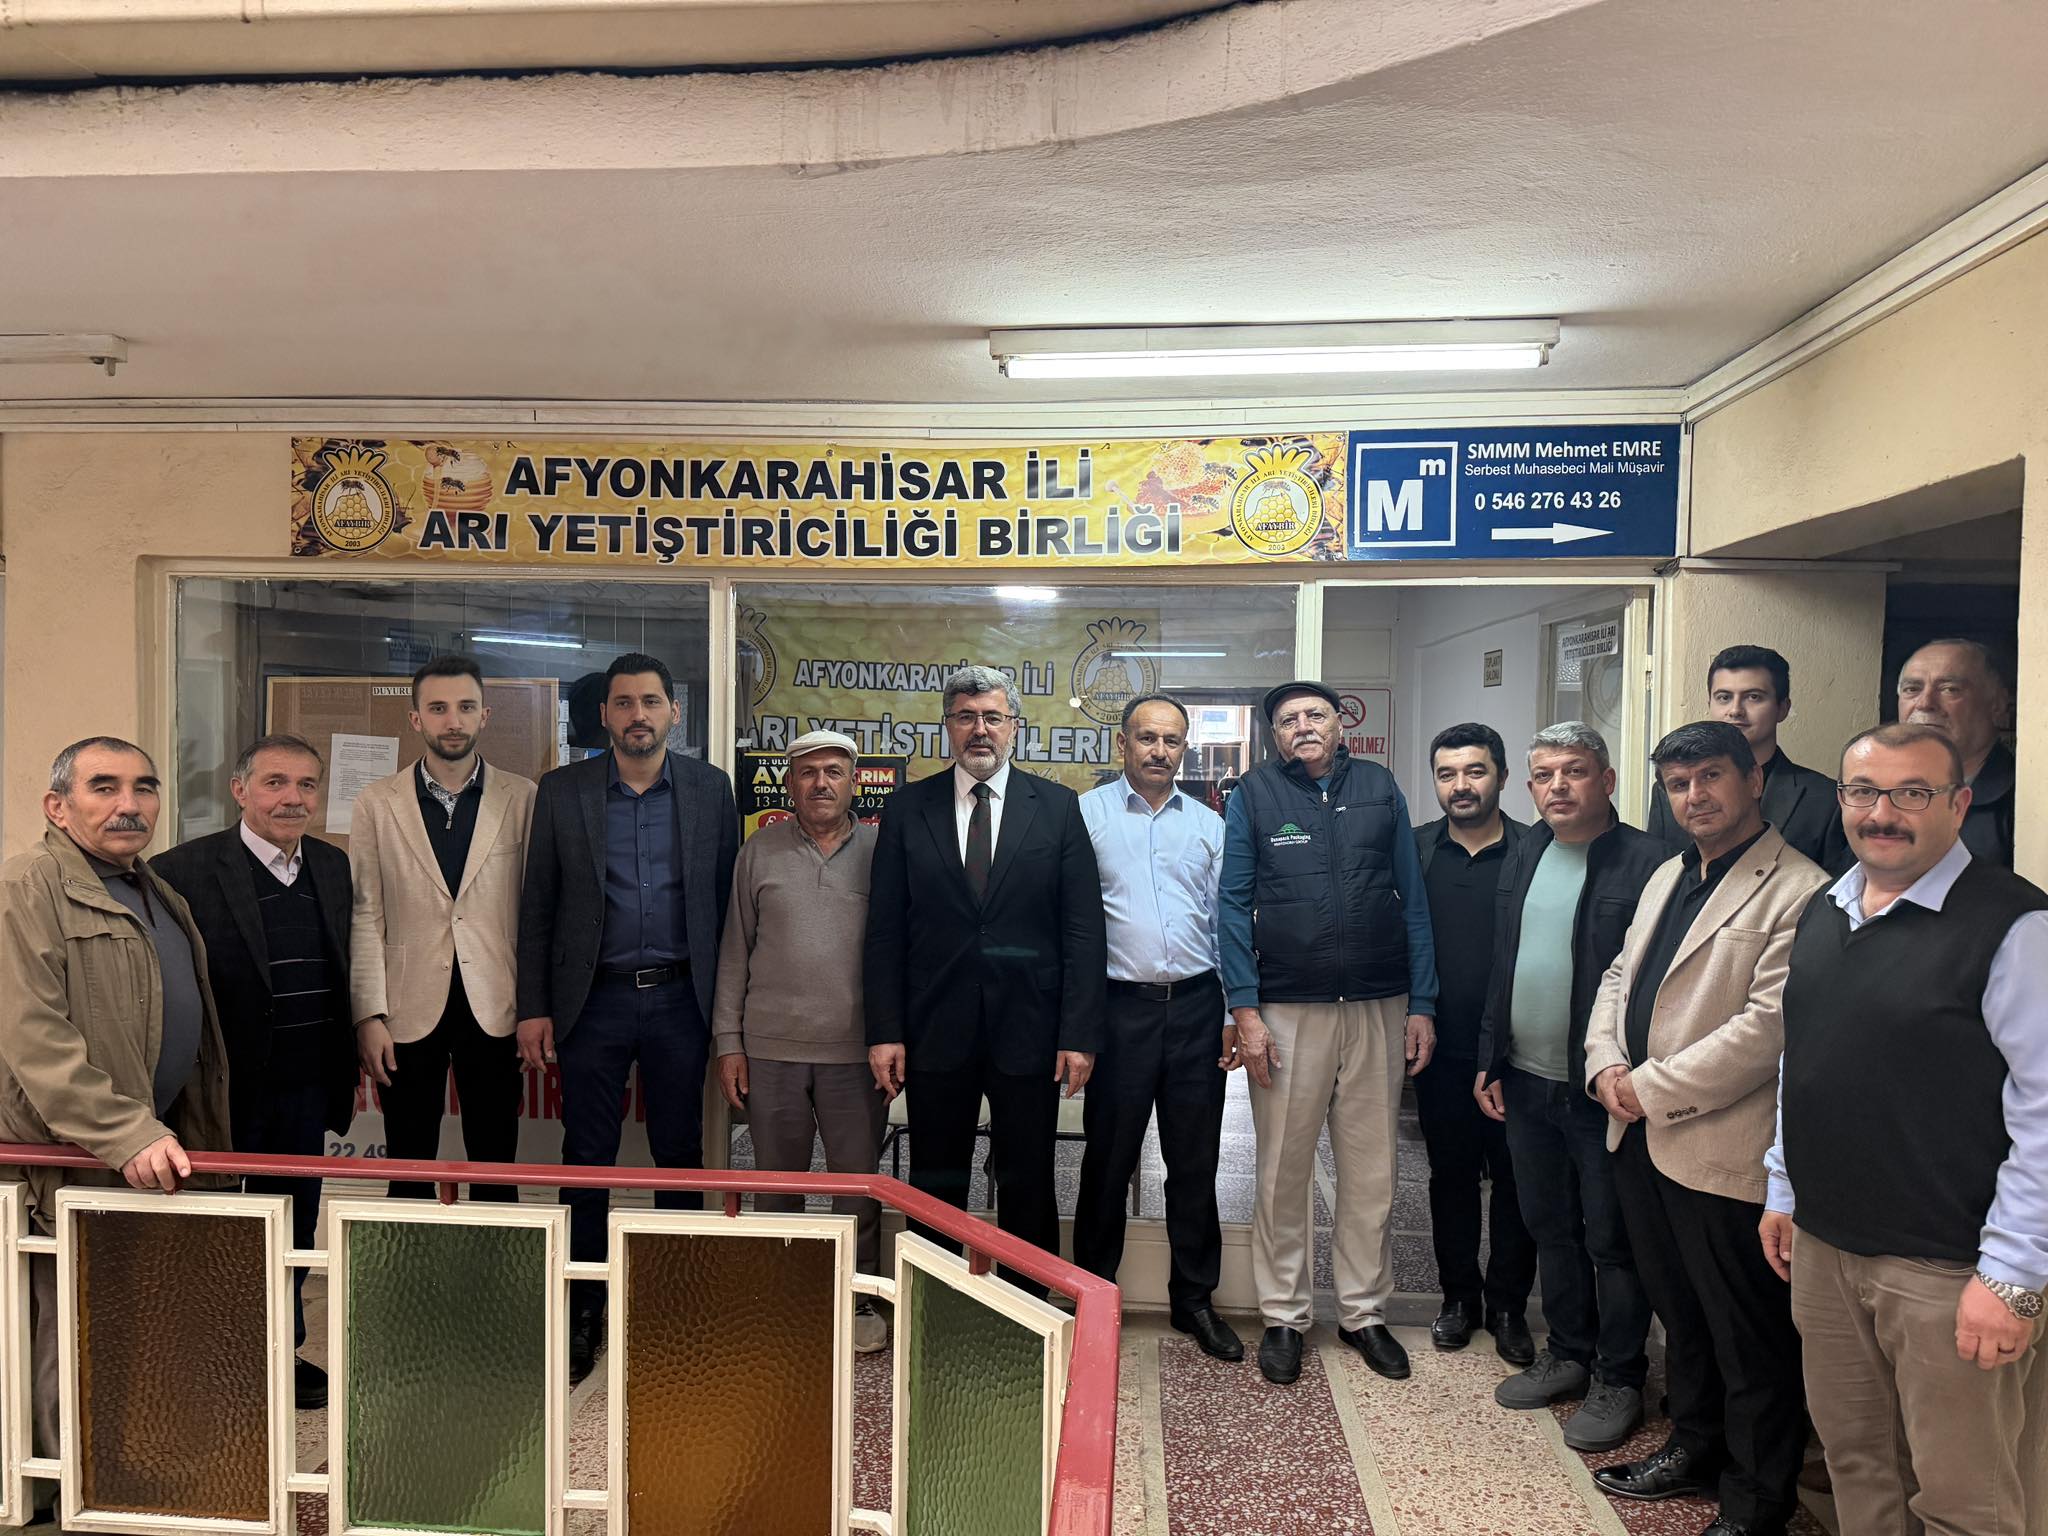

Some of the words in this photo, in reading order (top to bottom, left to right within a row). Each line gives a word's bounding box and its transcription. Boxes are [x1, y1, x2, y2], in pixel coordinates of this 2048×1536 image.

[1467, 442, 1530, 459] SMMM
[1536, 441, 1608, 458] Mehmet
[1613, 440, 1662, 457] EMRE
[504, 453, 1008, 500] AFYONKARAHİSAR
[1027, 449, 1091, 499] İLİ
[1464, 463, 1511, 476] Serbest
[1514, 461, 1586, 475] Muhasebeci
[1589, 461, 1614, 474] Mali
[1617, 461, 1665, 477] Müşavir
[1367, 479, 1424, 532] M
[1474, 493, 1486, 510] 0
[1491, 492, 1526, 510] 546
[1530, 491, 1565, 509] 276
[1569, 491, 1593, 509] 43
[1598, 491, 1622, 508] 26
[418, 510, 509, 551] ARI
[527, 506, 959, 563] YETİŞTİRİCİLİĞİ
[978, 504, 1181, 556] BİRLİĞİ
[1022, 661, 1055, 695] İLİ
[1349, 732, 1385, 756] İÇİLMEZ
[752, 765, 790, 785] AY
[753, 785, 778, 794] GIDA
[780, 785, 788, 794] &
[756, 795, 796, 807] 13-16
[857, 796, 885, 808] 202
